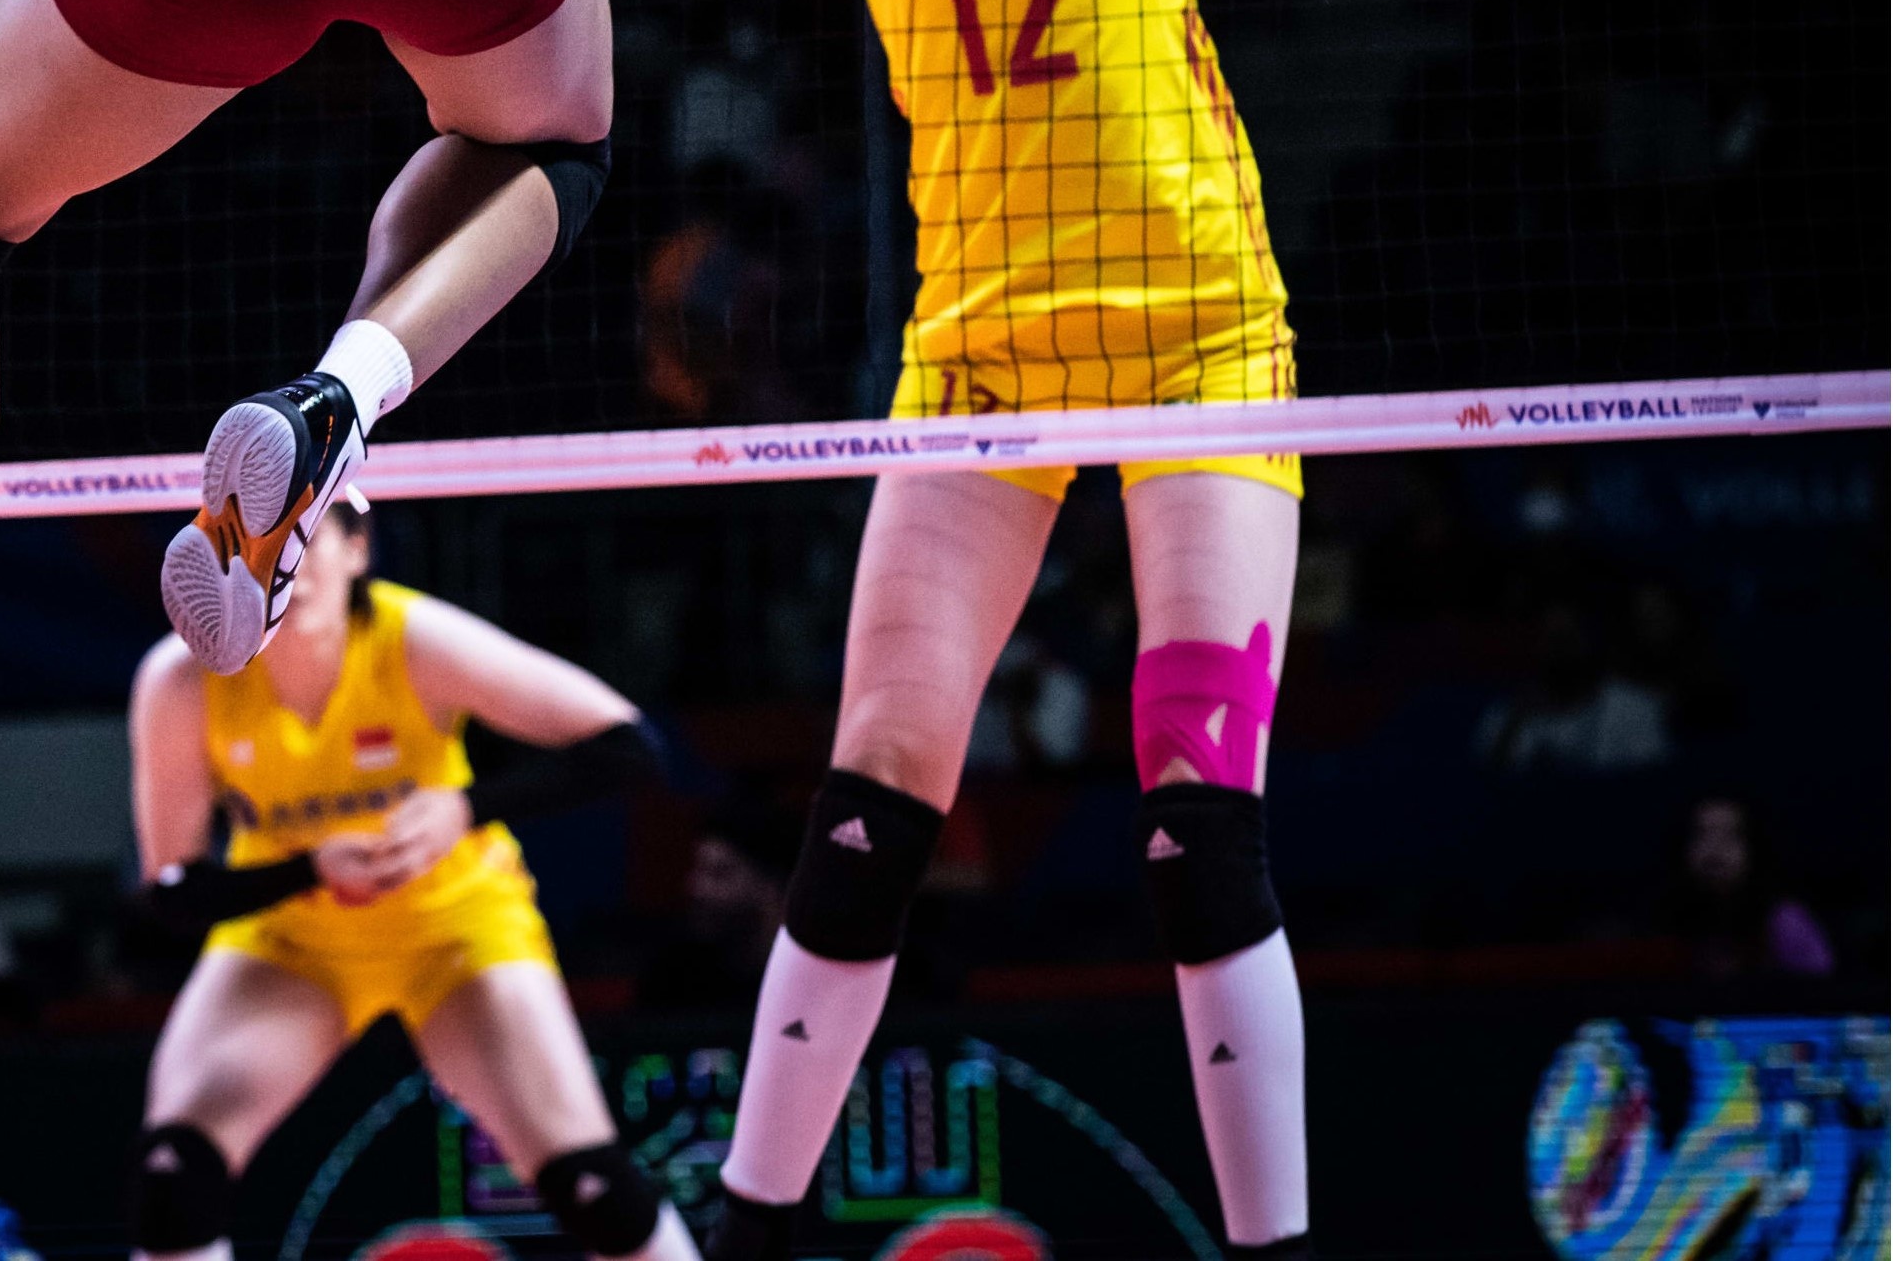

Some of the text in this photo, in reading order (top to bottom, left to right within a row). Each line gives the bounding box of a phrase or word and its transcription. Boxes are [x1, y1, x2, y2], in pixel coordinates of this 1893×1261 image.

[1508, 396, 1686, 425] VOLLEYBALL
[742, 435, 914, 462] VOLLEYBALL
[3, 473, 170, 498] VOLLEYBALL
